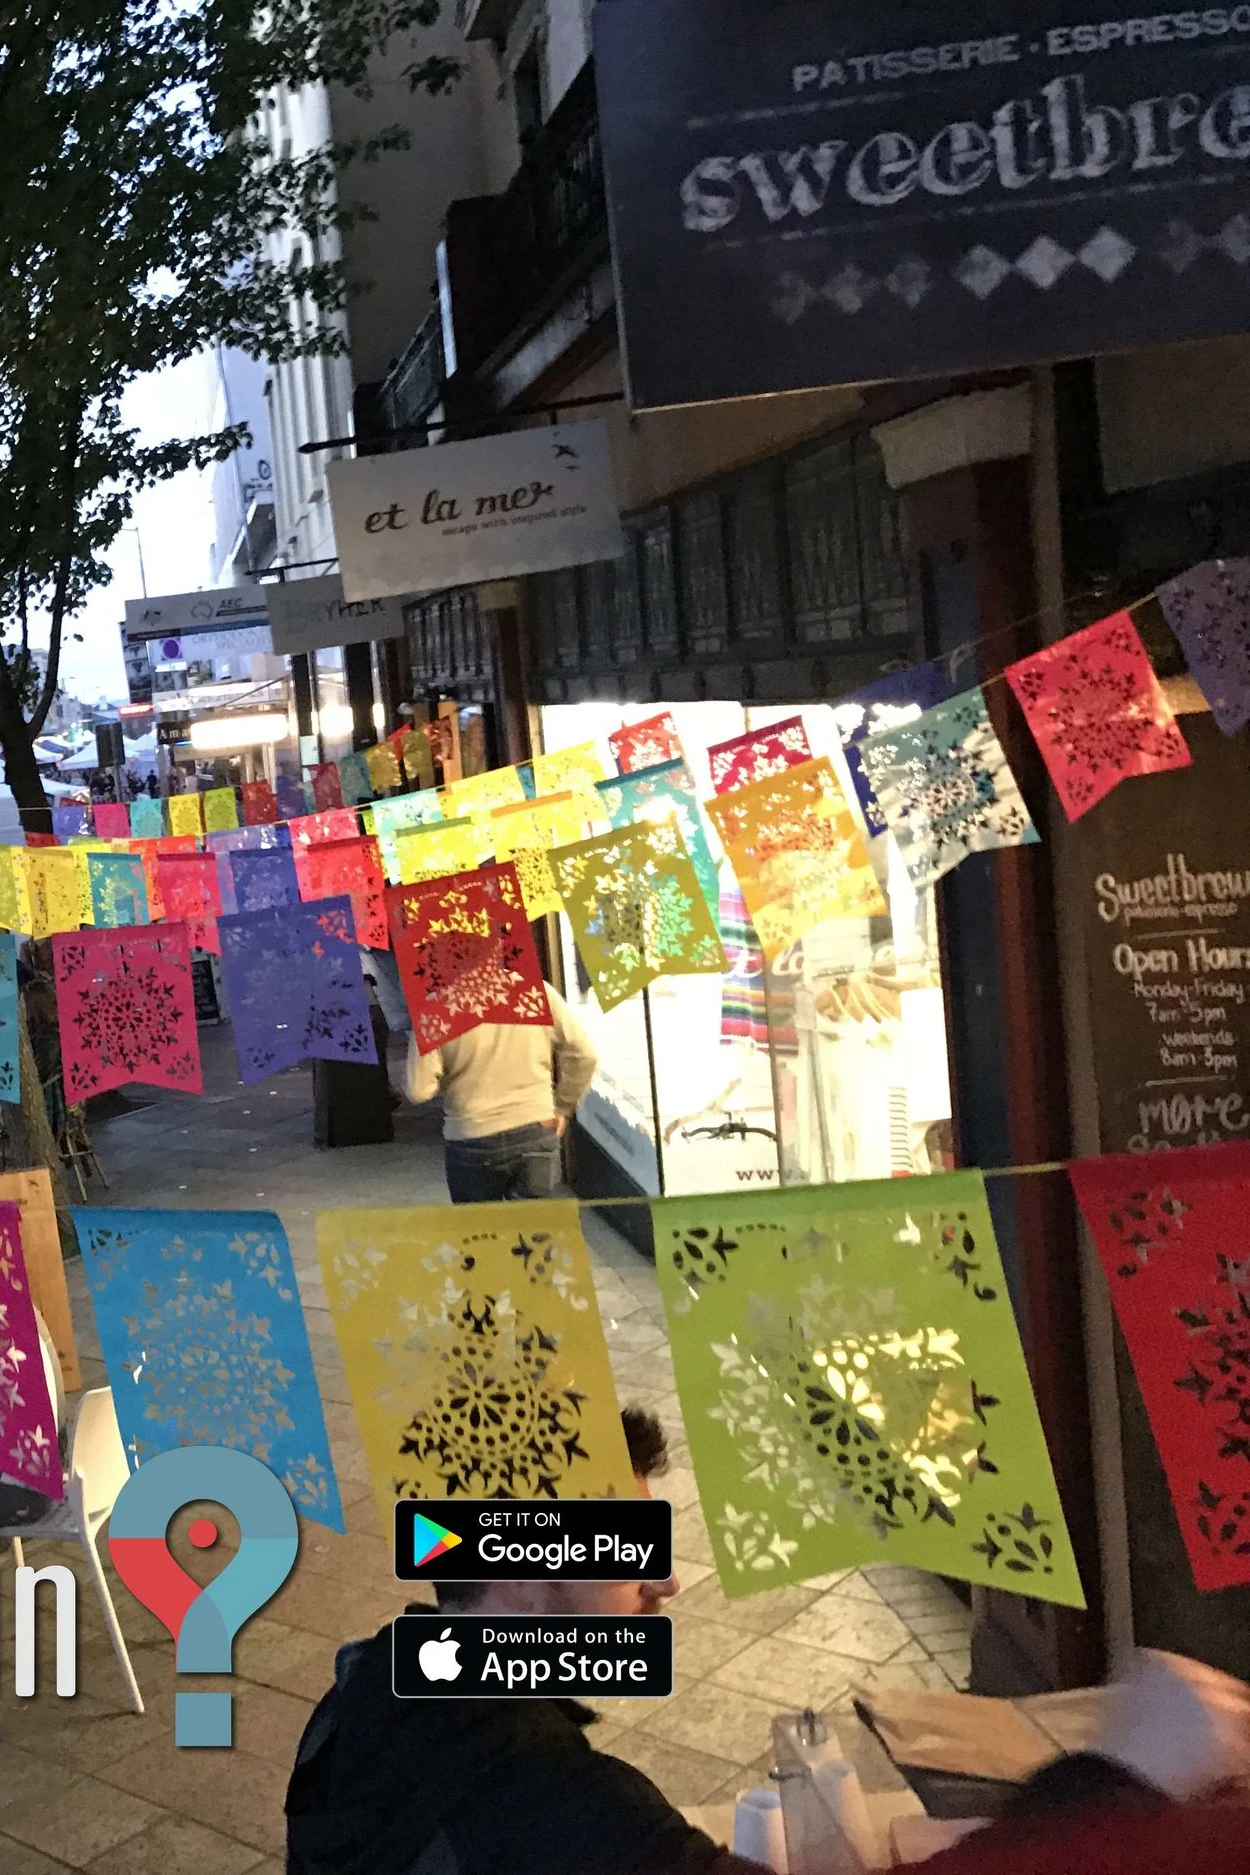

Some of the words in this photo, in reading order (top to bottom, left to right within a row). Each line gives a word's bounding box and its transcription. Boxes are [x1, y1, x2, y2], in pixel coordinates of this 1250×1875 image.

[792, 34, 1021, 92] PATISSERIE
[364, 502, 407, 534] et
[420, 488, 461, 525] la
[474, 480, 554, 516] mer
[1113, 943, 1179, 980] Open
